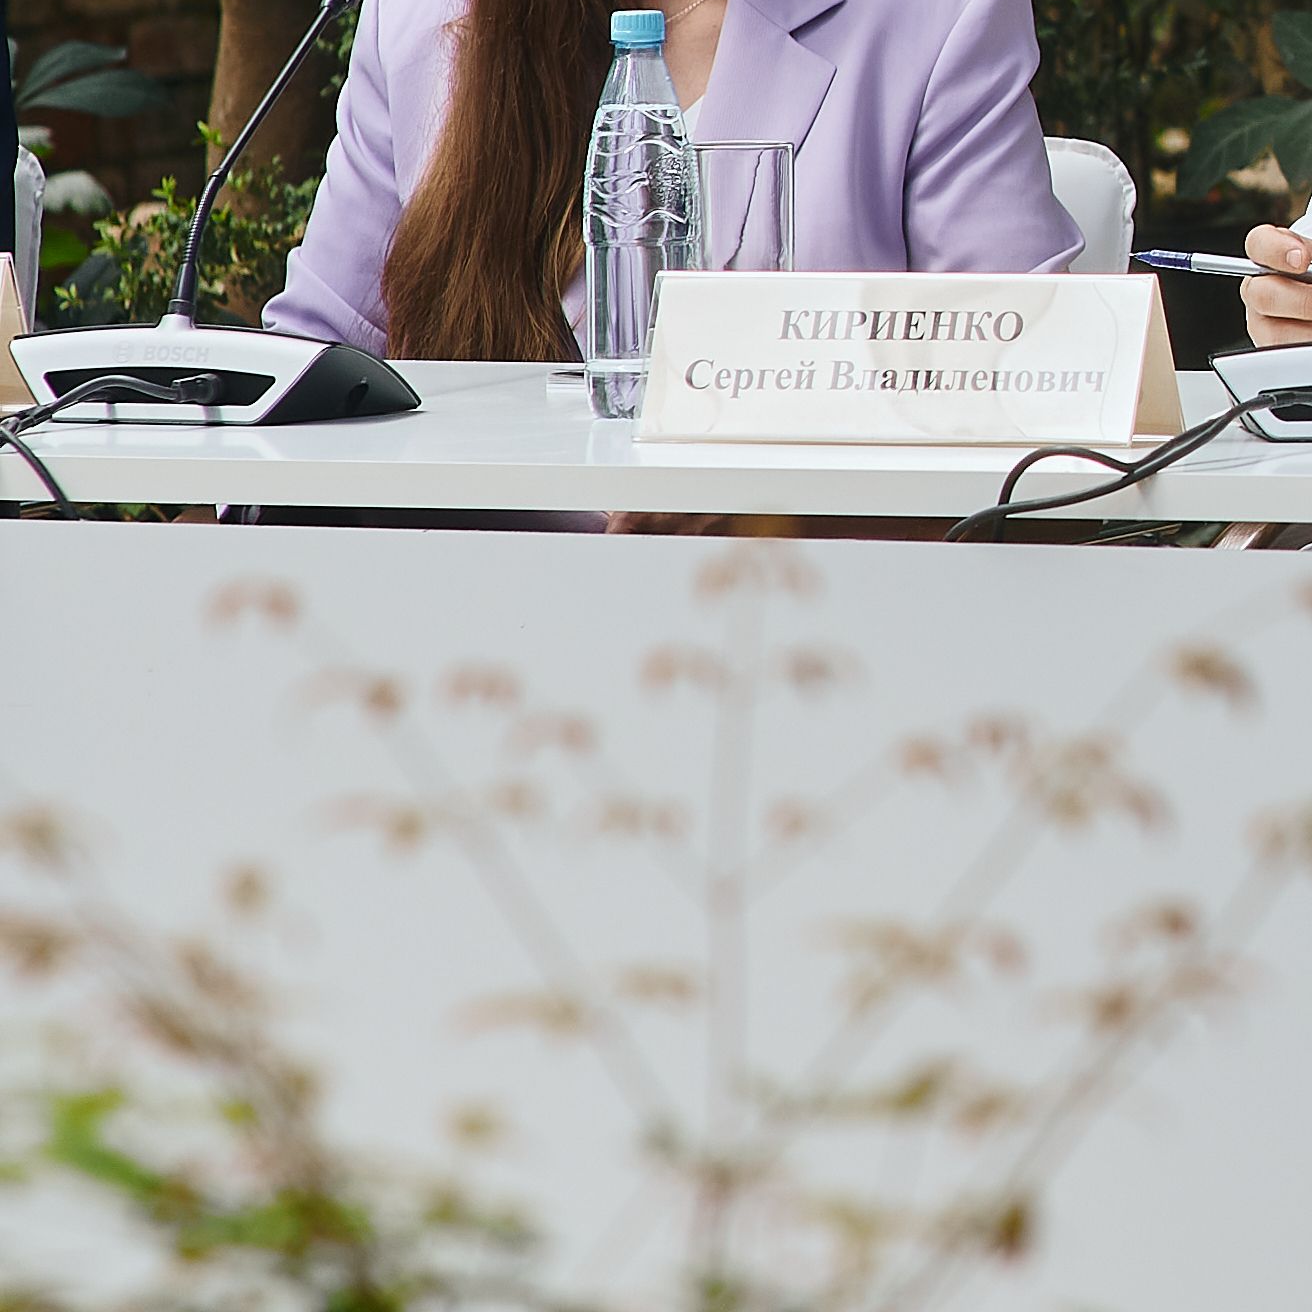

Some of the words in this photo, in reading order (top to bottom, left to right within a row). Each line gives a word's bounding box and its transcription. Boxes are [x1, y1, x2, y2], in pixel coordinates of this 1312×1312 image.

[778, 308, 1024, 344] КИРИЕНКО
[142, 344, 210, 364] BOSCH
[684, 357, 816, 397] Сергей
[827, 359, 1105, 396] Владиленович
